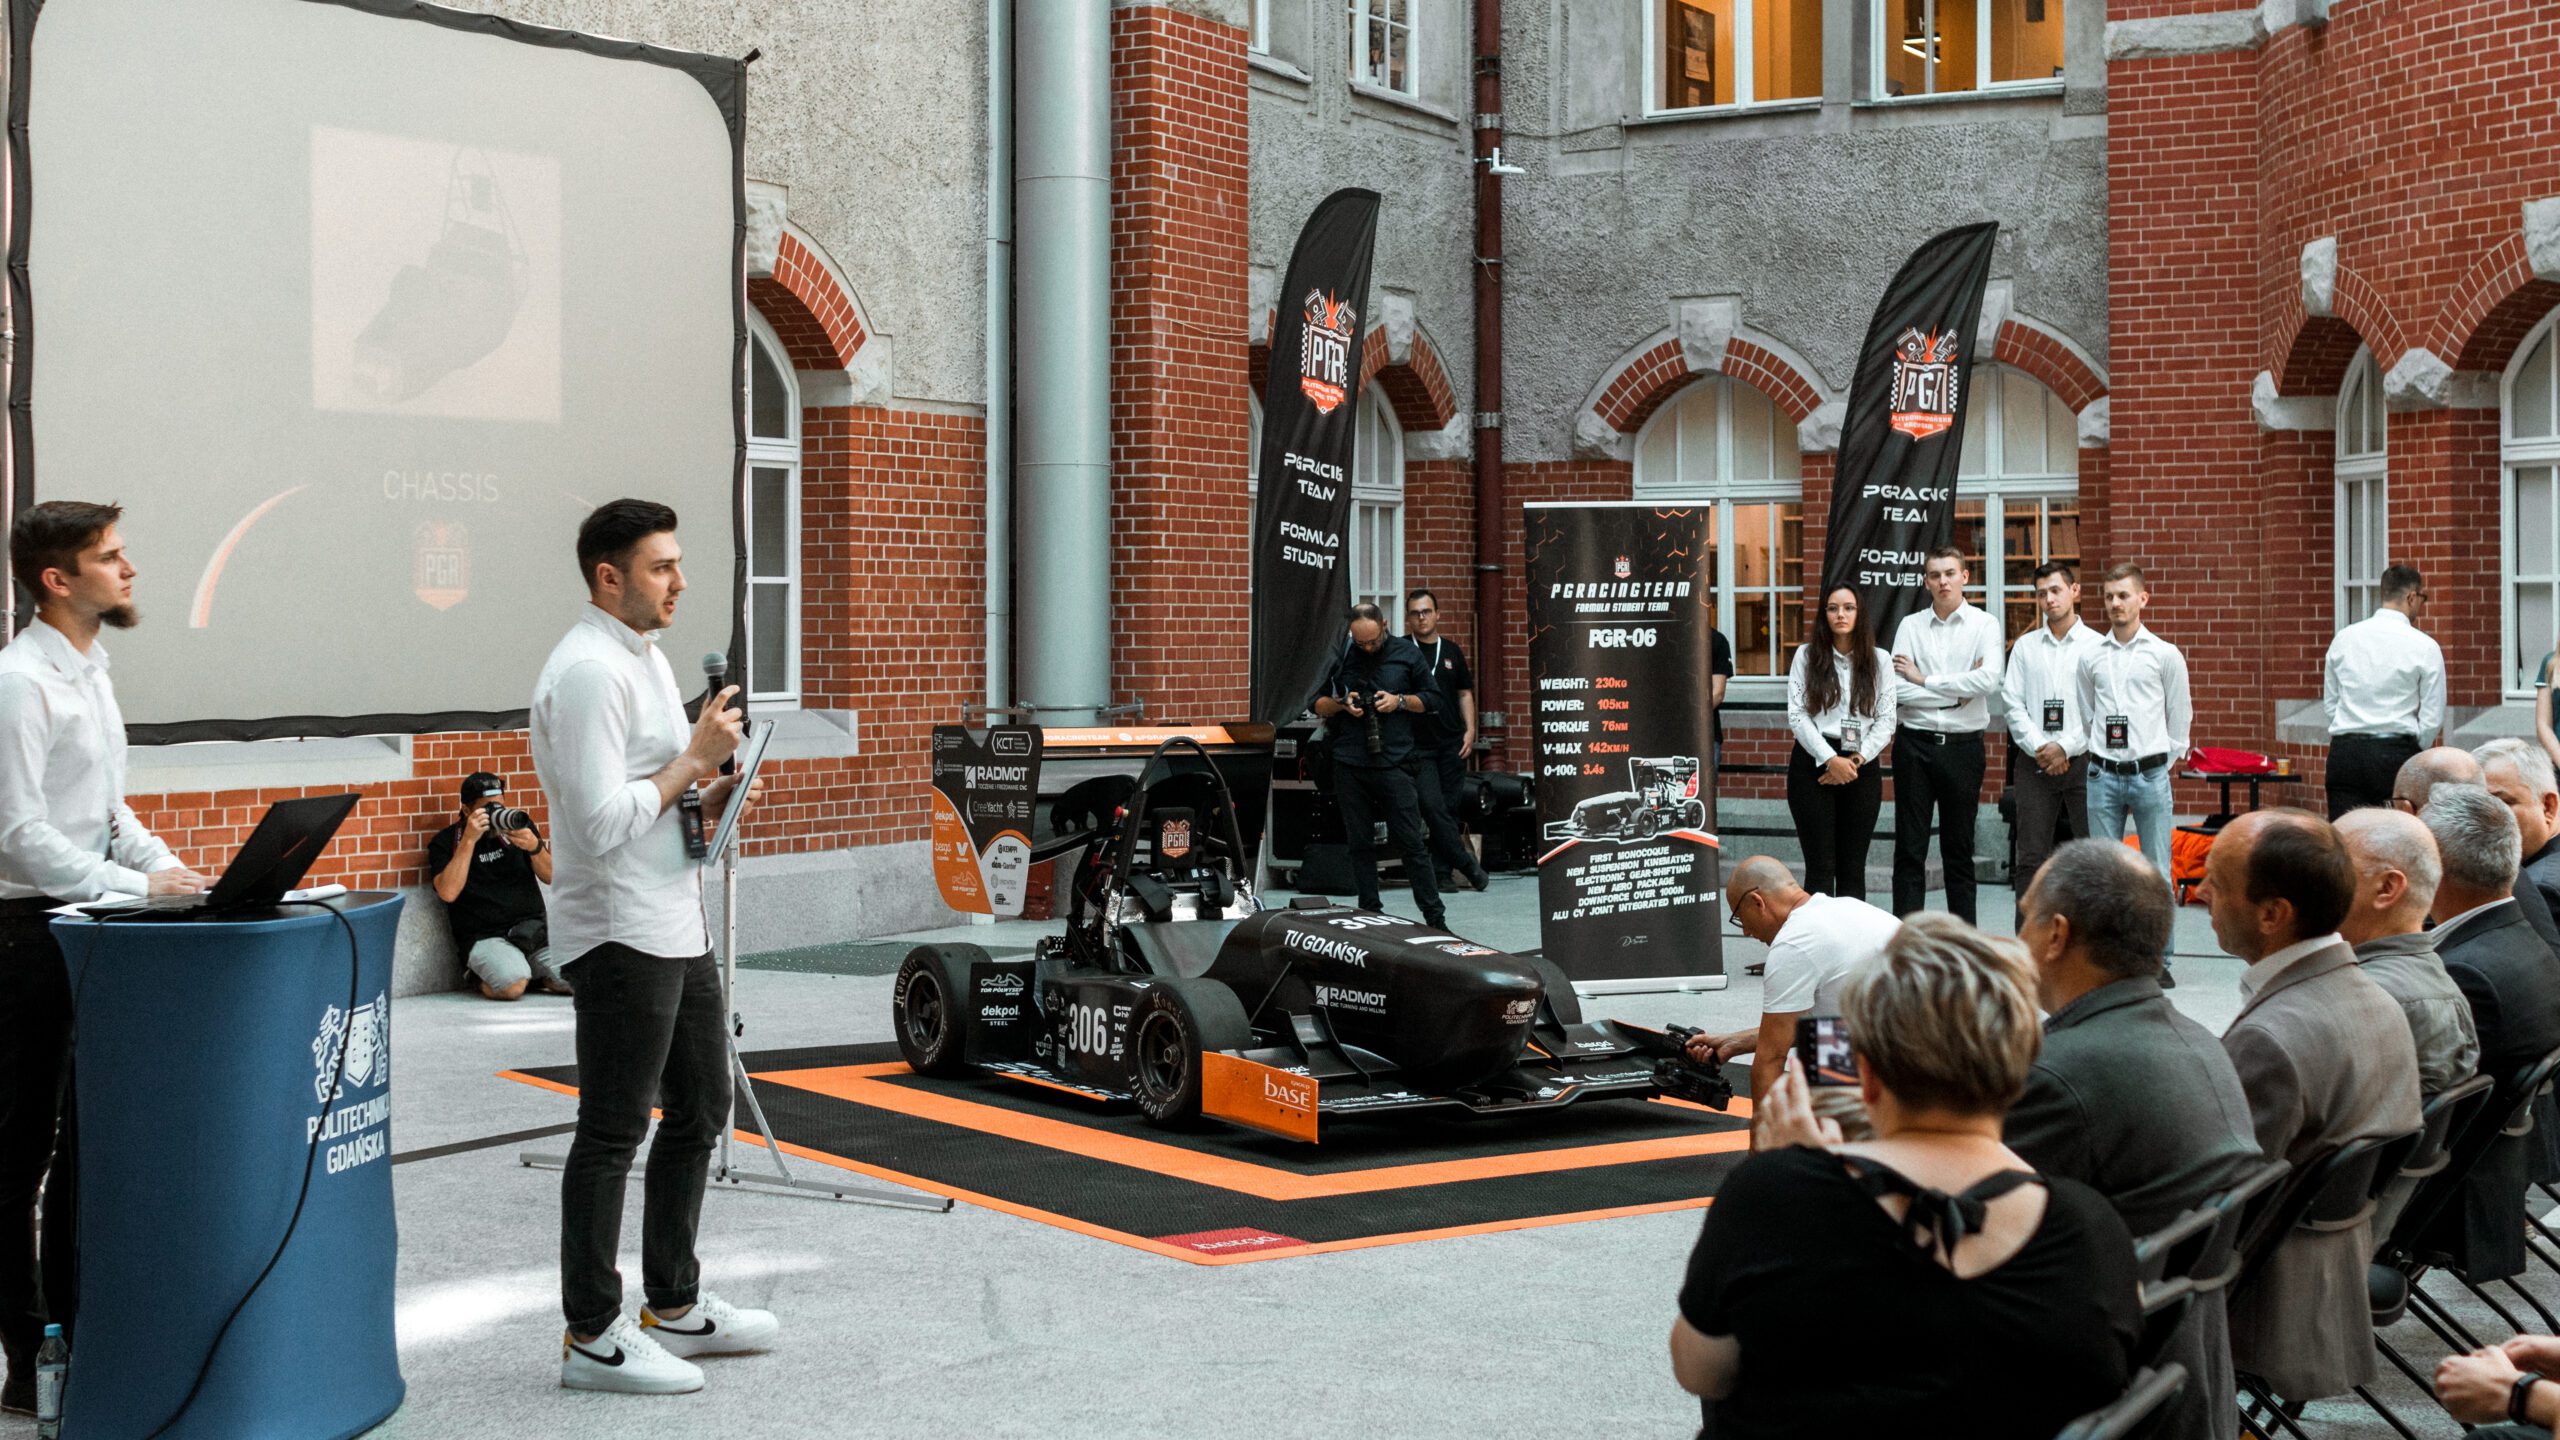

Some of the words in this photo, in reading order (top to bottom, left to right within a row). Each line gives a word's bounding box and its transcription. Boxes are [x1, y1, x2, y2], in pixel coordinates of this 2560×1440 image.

[384, 471, 498, 501] CHASSIS
[426, 554, 458, 584] PGR
[1575, 603, 1610, 613] FORMULA
[1612, 602, 1645, 612] STUDENT
[1648, 602, 1669, 612] TEAM
[1589, 628, 1657, 648] PGR-06
[1540, 678, 1588, 690] WEIGHT:
[1596, 678, 1627, 688] 230KG
[1541, 700, 1584, 711] POWER:
[1597, 700, 1629, 710] 105KM
[1542, 721, 1589, 733] TORQUE
[1602, 721, 1628, 731] 76NM
[996, 737, 1013, 750] KCT
[1543, 743, 1582, 755] V-MAX
[1588, 742, 1629, 753] 142KM/H
[978, 766, 1027, 781] RADMOT
[1544, 765, 1577, 776] 0-100:
[1583, 764, 1605, 775] 3.4s
[1168, 834, 1184, 847] PGR
[1590, 852, 1613, 864] FIRST
[1617, 846, 1670, 860] MONOCOQUE
[1566, 867, 1584, 878] NEW
[1590, 860, 1639, 874] SUSPENSION
[1644, 854, 1694, 867] KINEMATICS
[1575, 874, 1625, 886] ELECTRONIC
[1630, 865, 1691, 880] GEAR-SHIFTING
[1588, 885, 1606, 895] NEW
[1611, 882, 1632, 892] AERO
[1637, 877, 1674, 889] PACKAGE
[1578, 893, 1629, 907] DOWNFORCE
[1633, 889, 1655, 899] OVER
[1660, 886, 1684, 897] 1000N
[1552, 911, 1568, 921] ALU
[1573, 909, 1585, 918] CV
[1589, 905, 1614, 916] JOINT
[1618, 898, 1669, 912] INTEGRATED
[1673, 895, 1695, 906] WITH
[1700, 892, 1716, 902] HUB
[1328, 916, 1415, 929] 306
[1284, 930, 1304, 947] TU
[1302, 935, 1369, 968] GDAŃSK
[1330, 987, 1386, 1006] RADMOT
[981, 1005, 1018, 1018] dekpol
[1069, 1003, 1107, 1056] 306
[326, 1130, 385, 1175] GDAŃSKA
